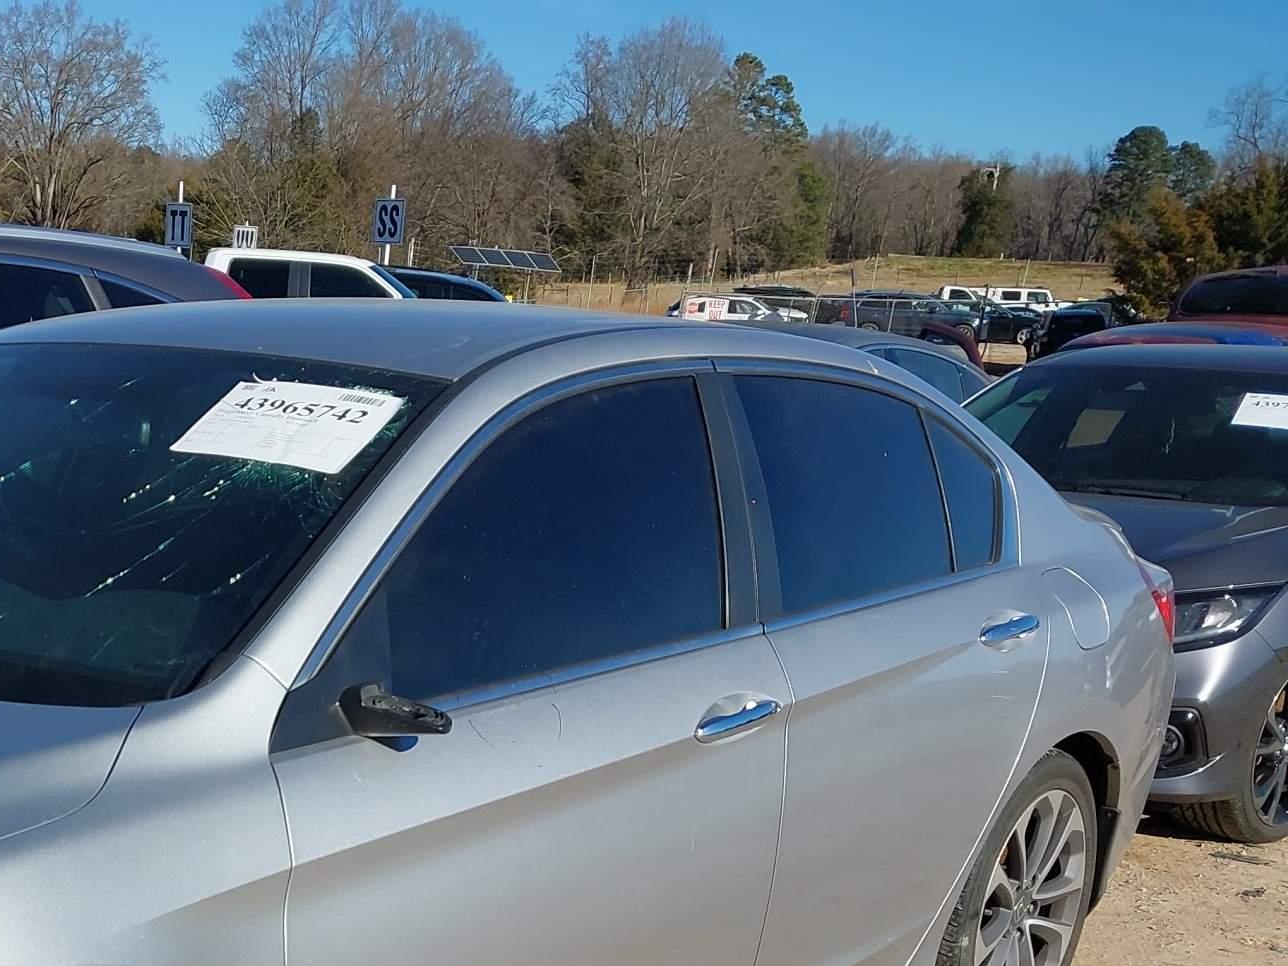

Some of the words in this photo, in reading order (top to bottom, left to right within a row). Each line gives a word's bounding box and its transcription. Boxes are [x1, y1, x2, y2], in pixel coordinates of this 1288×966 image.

[170, 209, 188, 242] TT
[378, 204, 400, 238] SS
[708, 299, 726, 309] KEEP
[708, 310, 723, 320] OUT
[234, 397, 369, 424] 43965742
